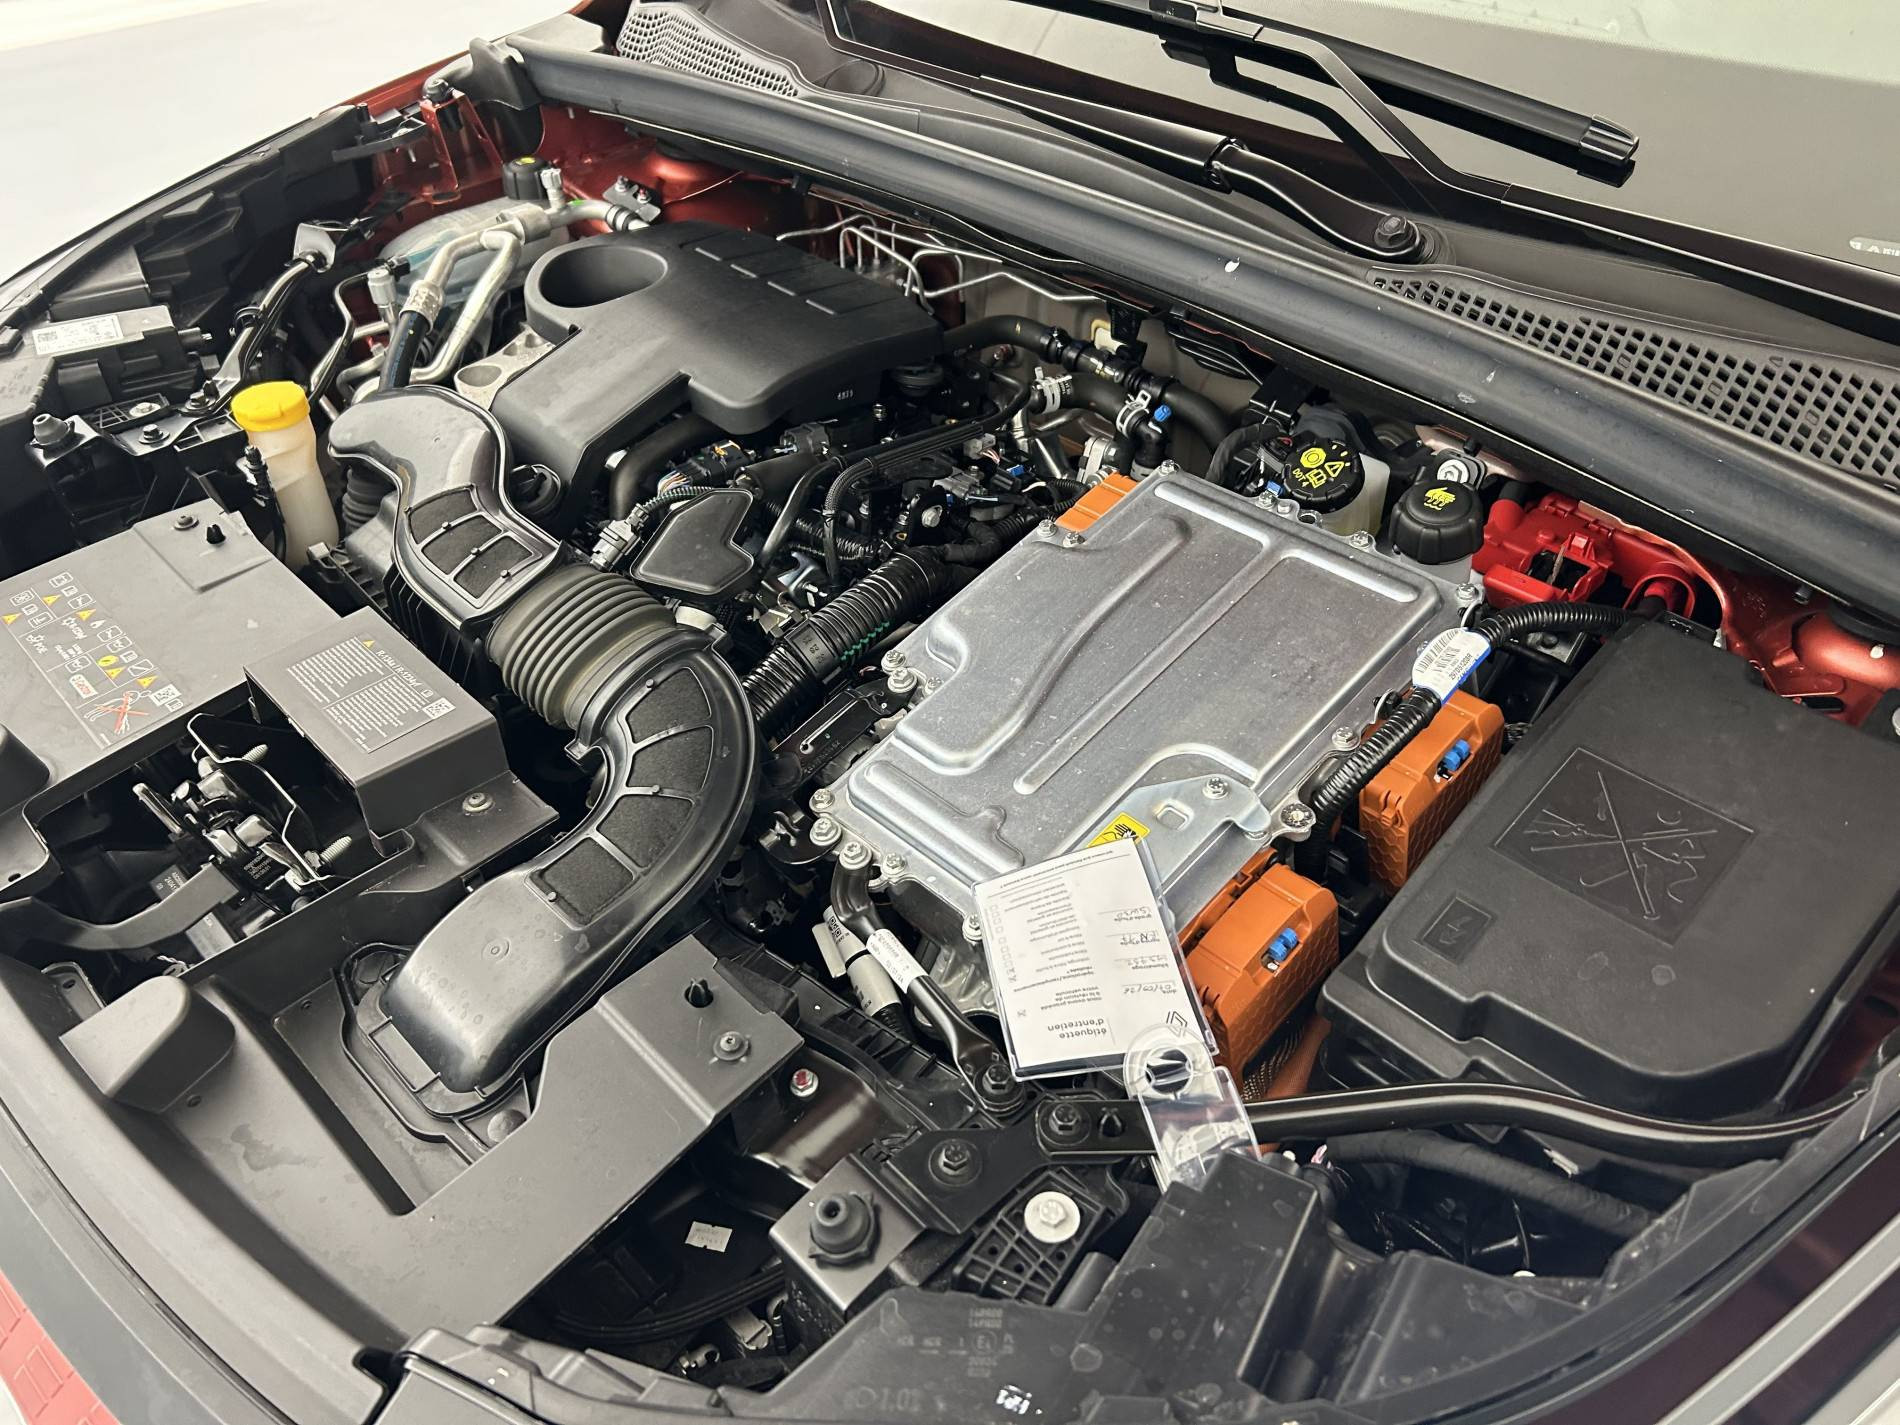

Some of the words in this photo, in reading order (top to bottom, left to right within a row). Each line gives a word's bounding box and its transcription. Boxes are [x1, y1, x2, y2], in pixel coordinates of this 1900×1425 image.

[1292, 468, 1306, 482] DOT
[1047, 1018, 1104, 1032] d'entretien
[1058, 1027, 1107, 1039] étiquette
